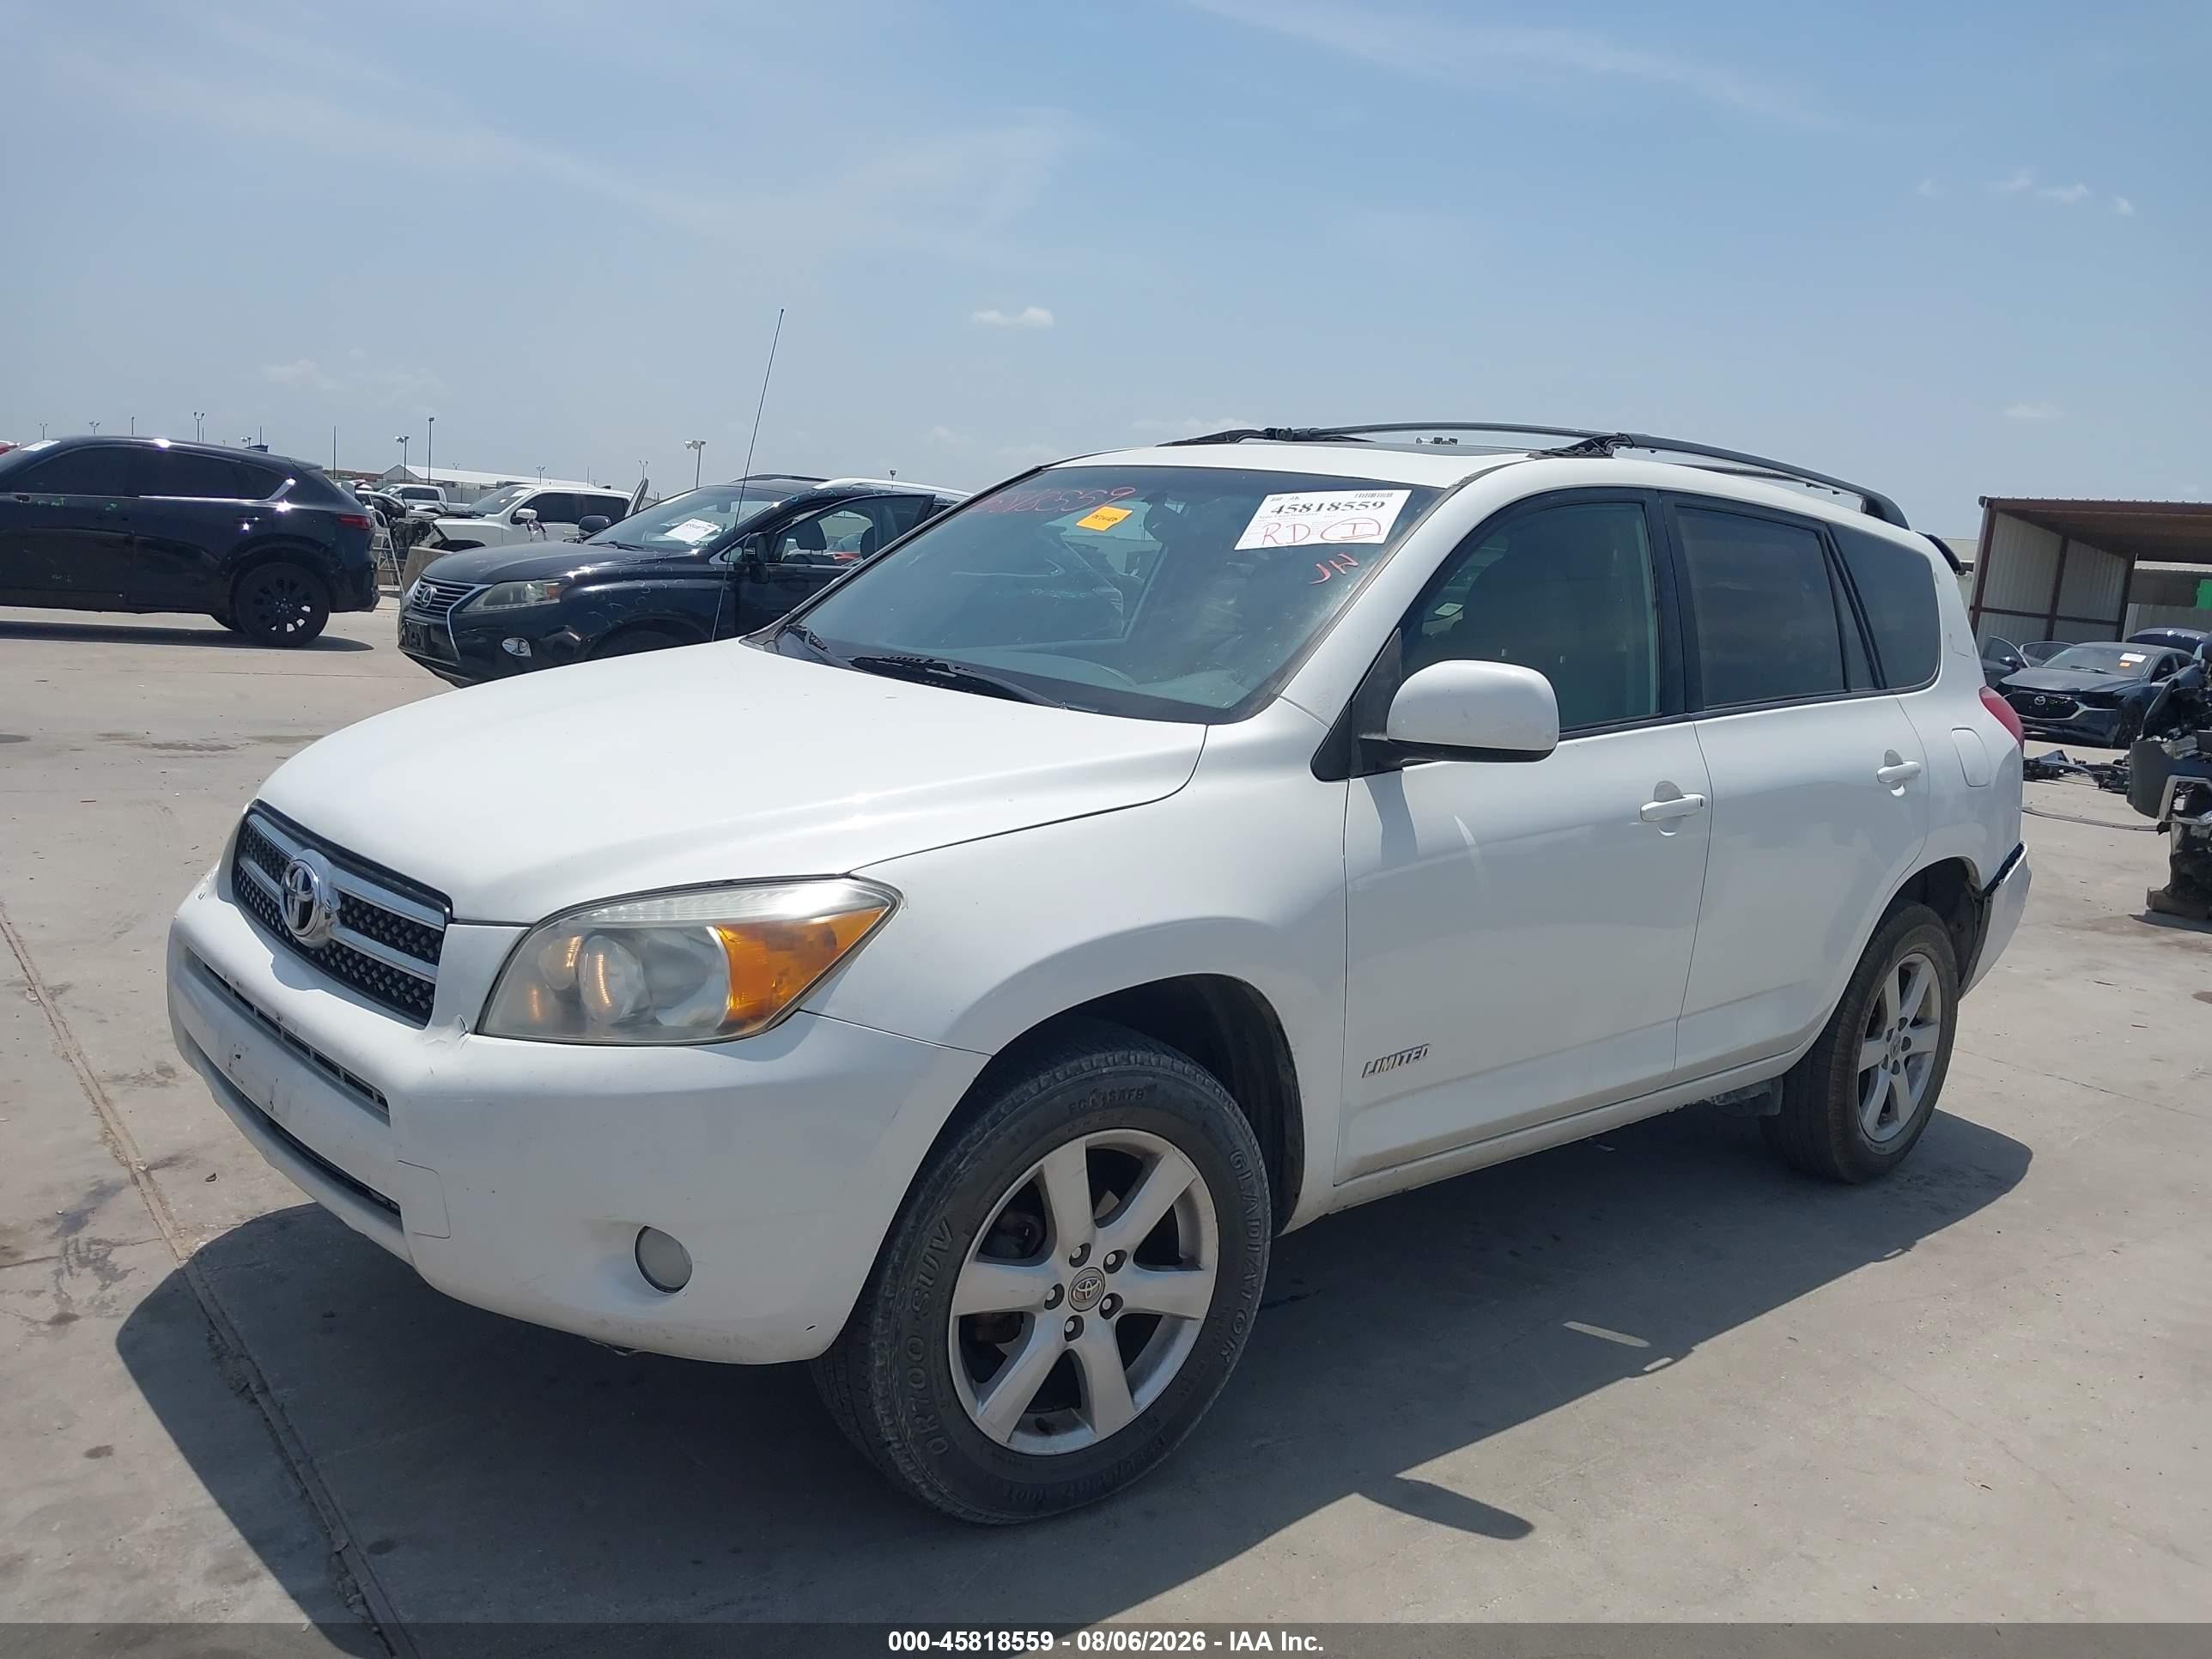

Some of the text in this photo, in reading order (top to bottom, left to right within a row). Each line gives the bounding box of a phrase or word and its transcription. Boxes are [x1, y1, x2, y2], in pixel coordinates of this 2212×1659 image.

[1271, 501, 1385, 514] 45818559
[1361, 1043, 1430, 1079] LIMITED
[1220, 1147, 1262, 1362] GLADIATOR
